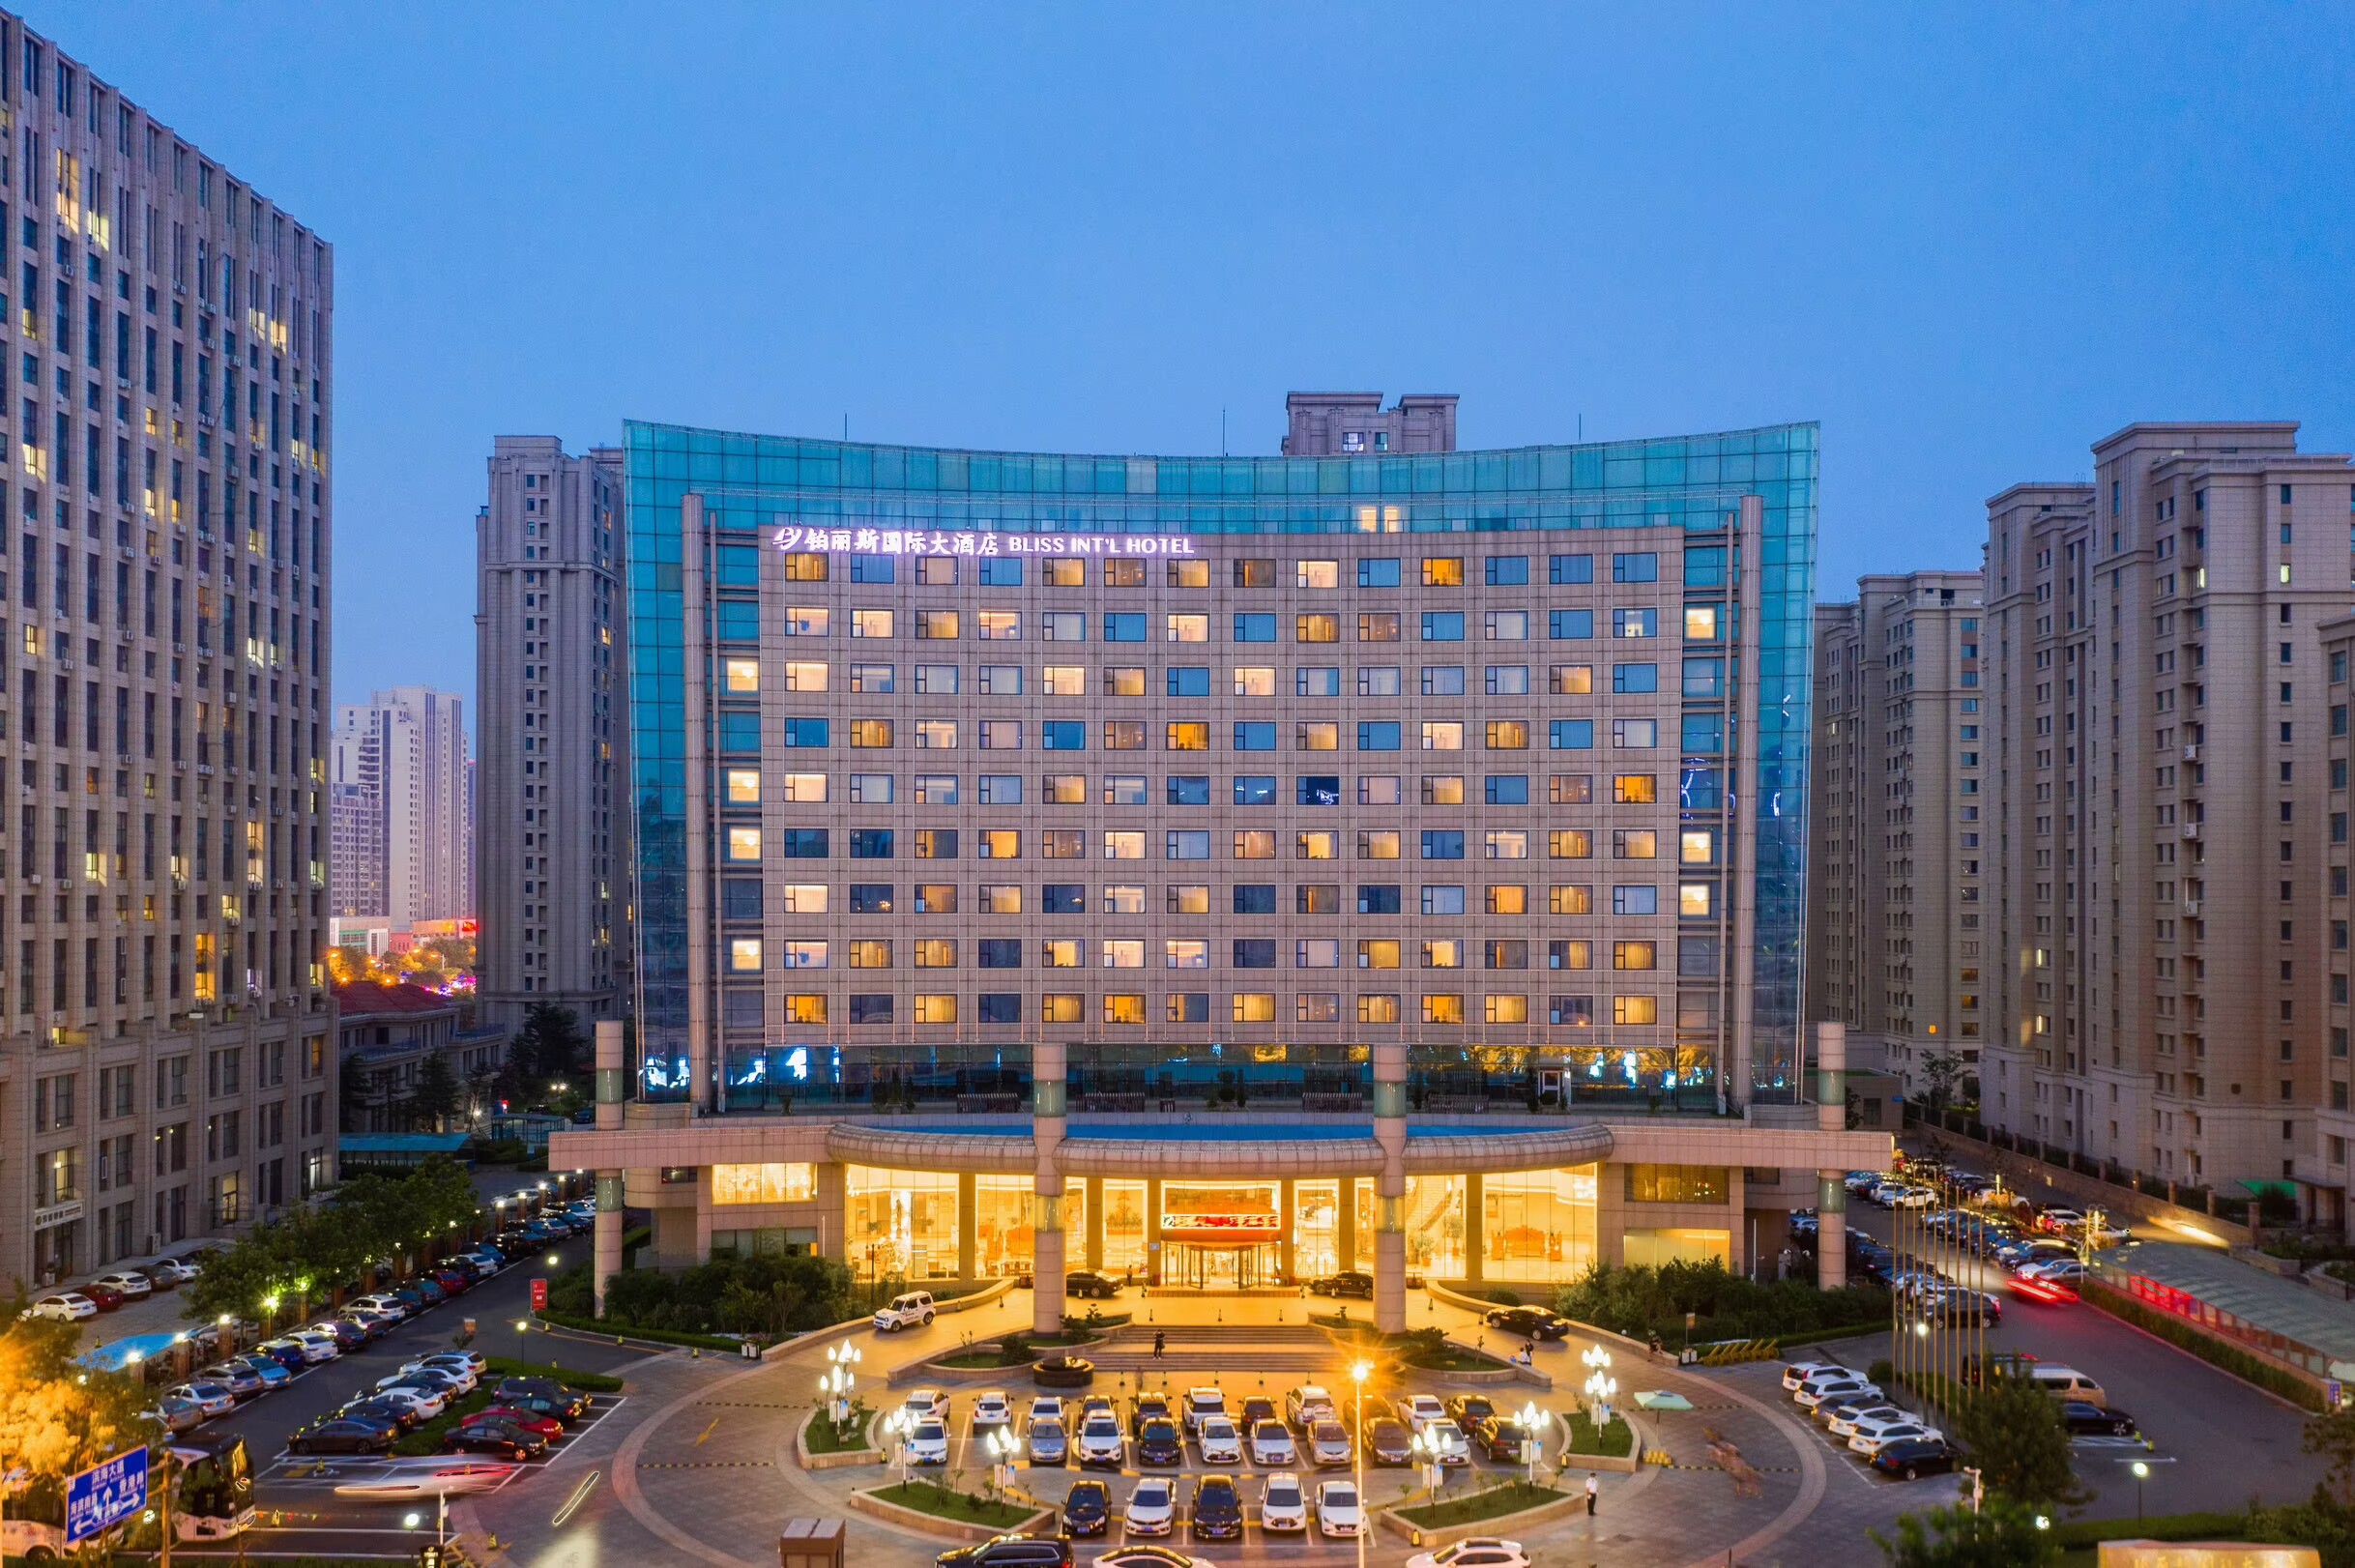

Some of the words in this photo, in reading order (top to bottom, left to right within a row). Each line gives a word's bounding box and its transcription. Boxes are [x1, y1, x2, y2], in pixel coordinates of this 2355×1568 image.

[803, 528, 999, 556] 铂丽斯国际大酒店
[1008, 537, 1064, 553] BLISS
[1070, 537, 1121, 554] INT'L
[1126, 537, 1195, 555] HOTEL
